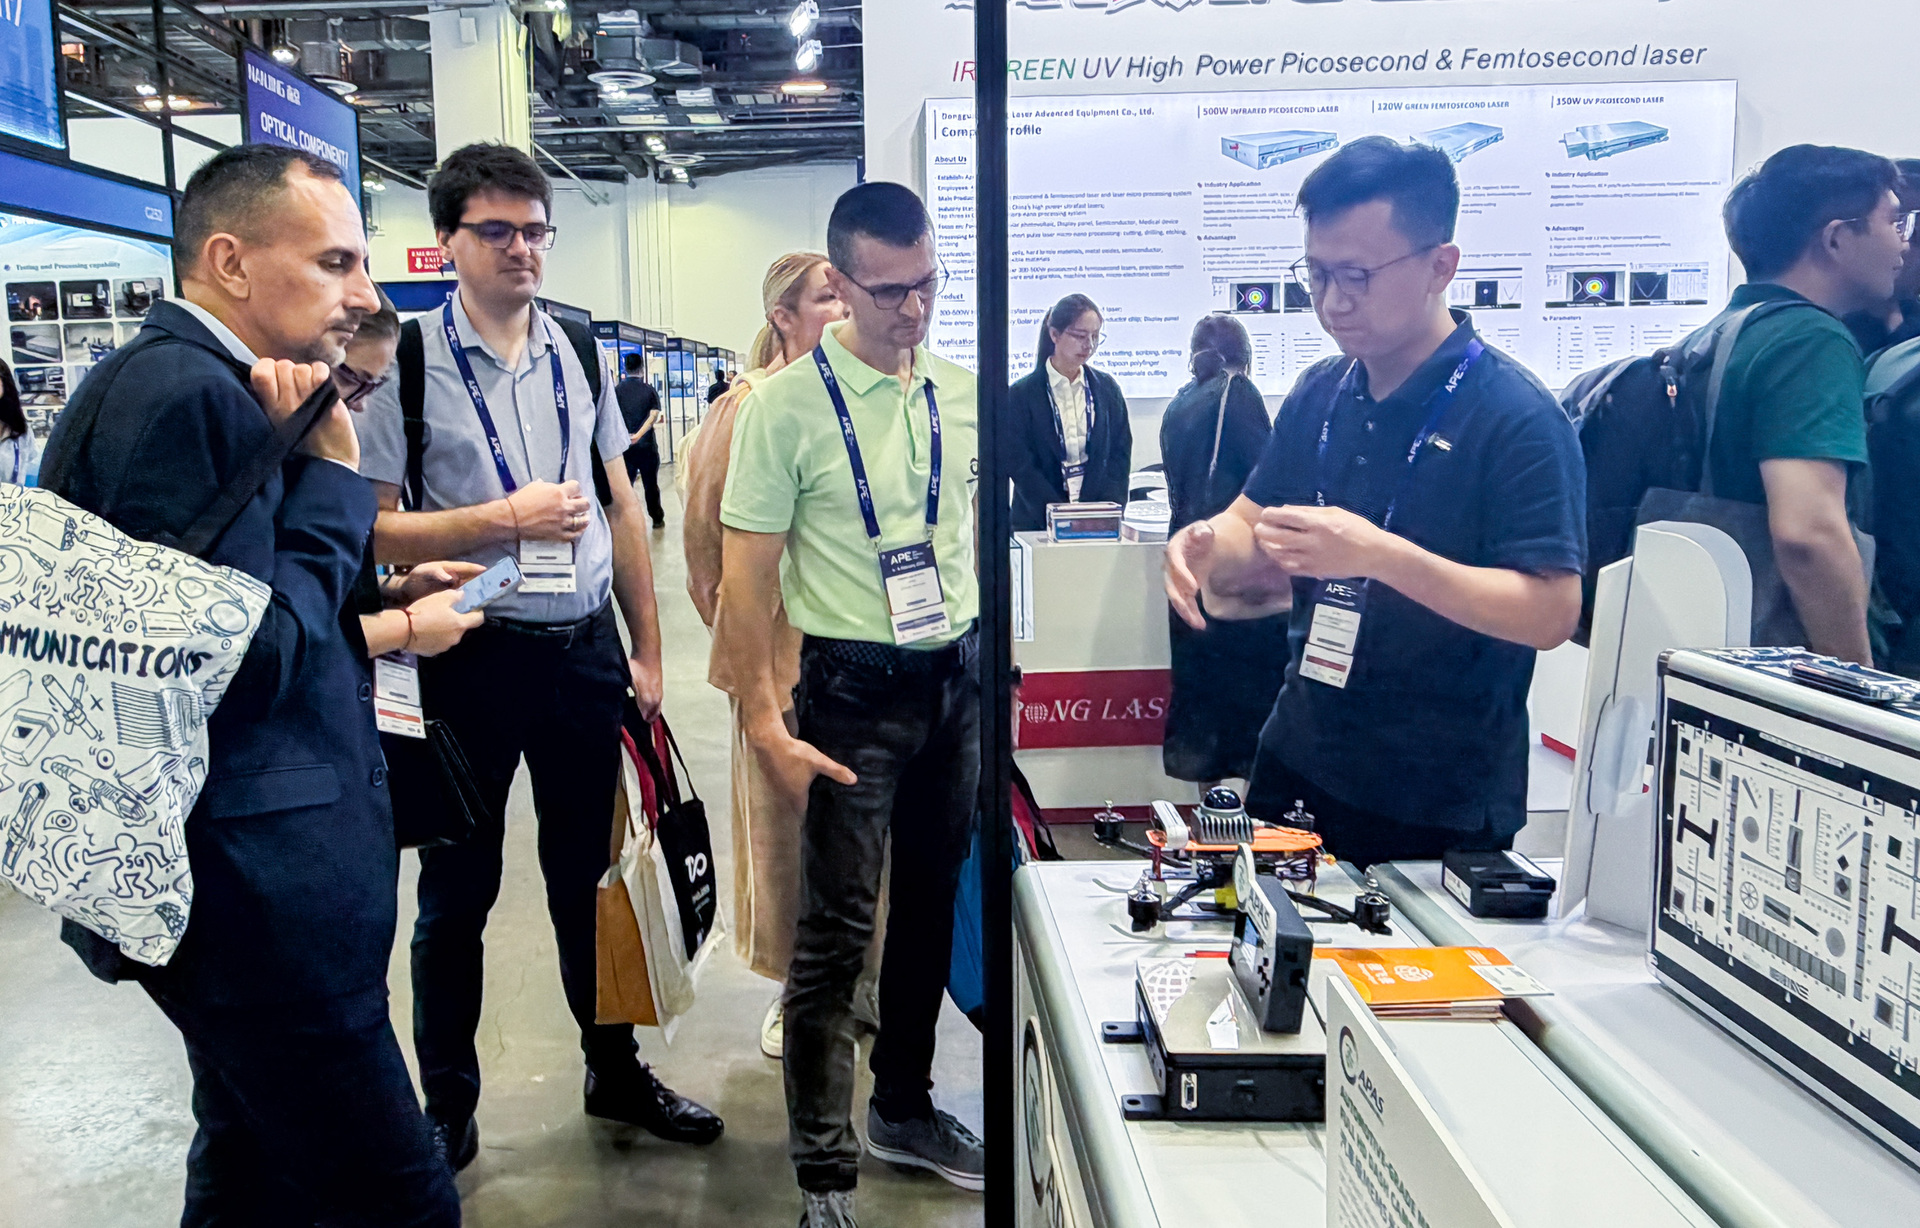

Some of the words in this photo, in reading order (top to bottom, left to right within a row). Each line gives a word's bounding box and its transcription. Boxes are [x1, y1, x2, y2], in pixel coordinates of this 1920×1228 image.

[1007, 57, 1076, 82] REEN
[1082, 56, 1122, 79] UV
[1126, 54, 1184, 83] High
[1196, 53, 1276, 76] Power
[1280, 49, 1429, 75] Picosecond
[1435, 48, 1453, 71] &
[1460, 44, 1638, 70] Femtosecond
[1642, 44, 1708, 66] laser
[1203, 106, 1229, 116] 500W
[1317, 105, 1339, 113] LASER
[1377, 102, 1403, 111] 120W
[1405, 102, 1429, 110] GREEN
[1431, 101, 1486, 110] FEMTOSECOND
[1487, 101, 1510, 109] LASER
[1556, 97, 1582, 106] 150W
[260, 111, 299, 147] OPTICAL
[1009, 124, 1042, 136] rofile
[467, 379, 481, 401] APE
[1444, 368, 1464, 394] APE
[840, 416, 853, 438] APE
[490, 436, 503, 457] APE
[857, 478, 869, 500] APE
[931, 474, 939, 497] APE
[890, 551, 913, 567] APE
[1358, 1069, 1385, 1114] APAS
